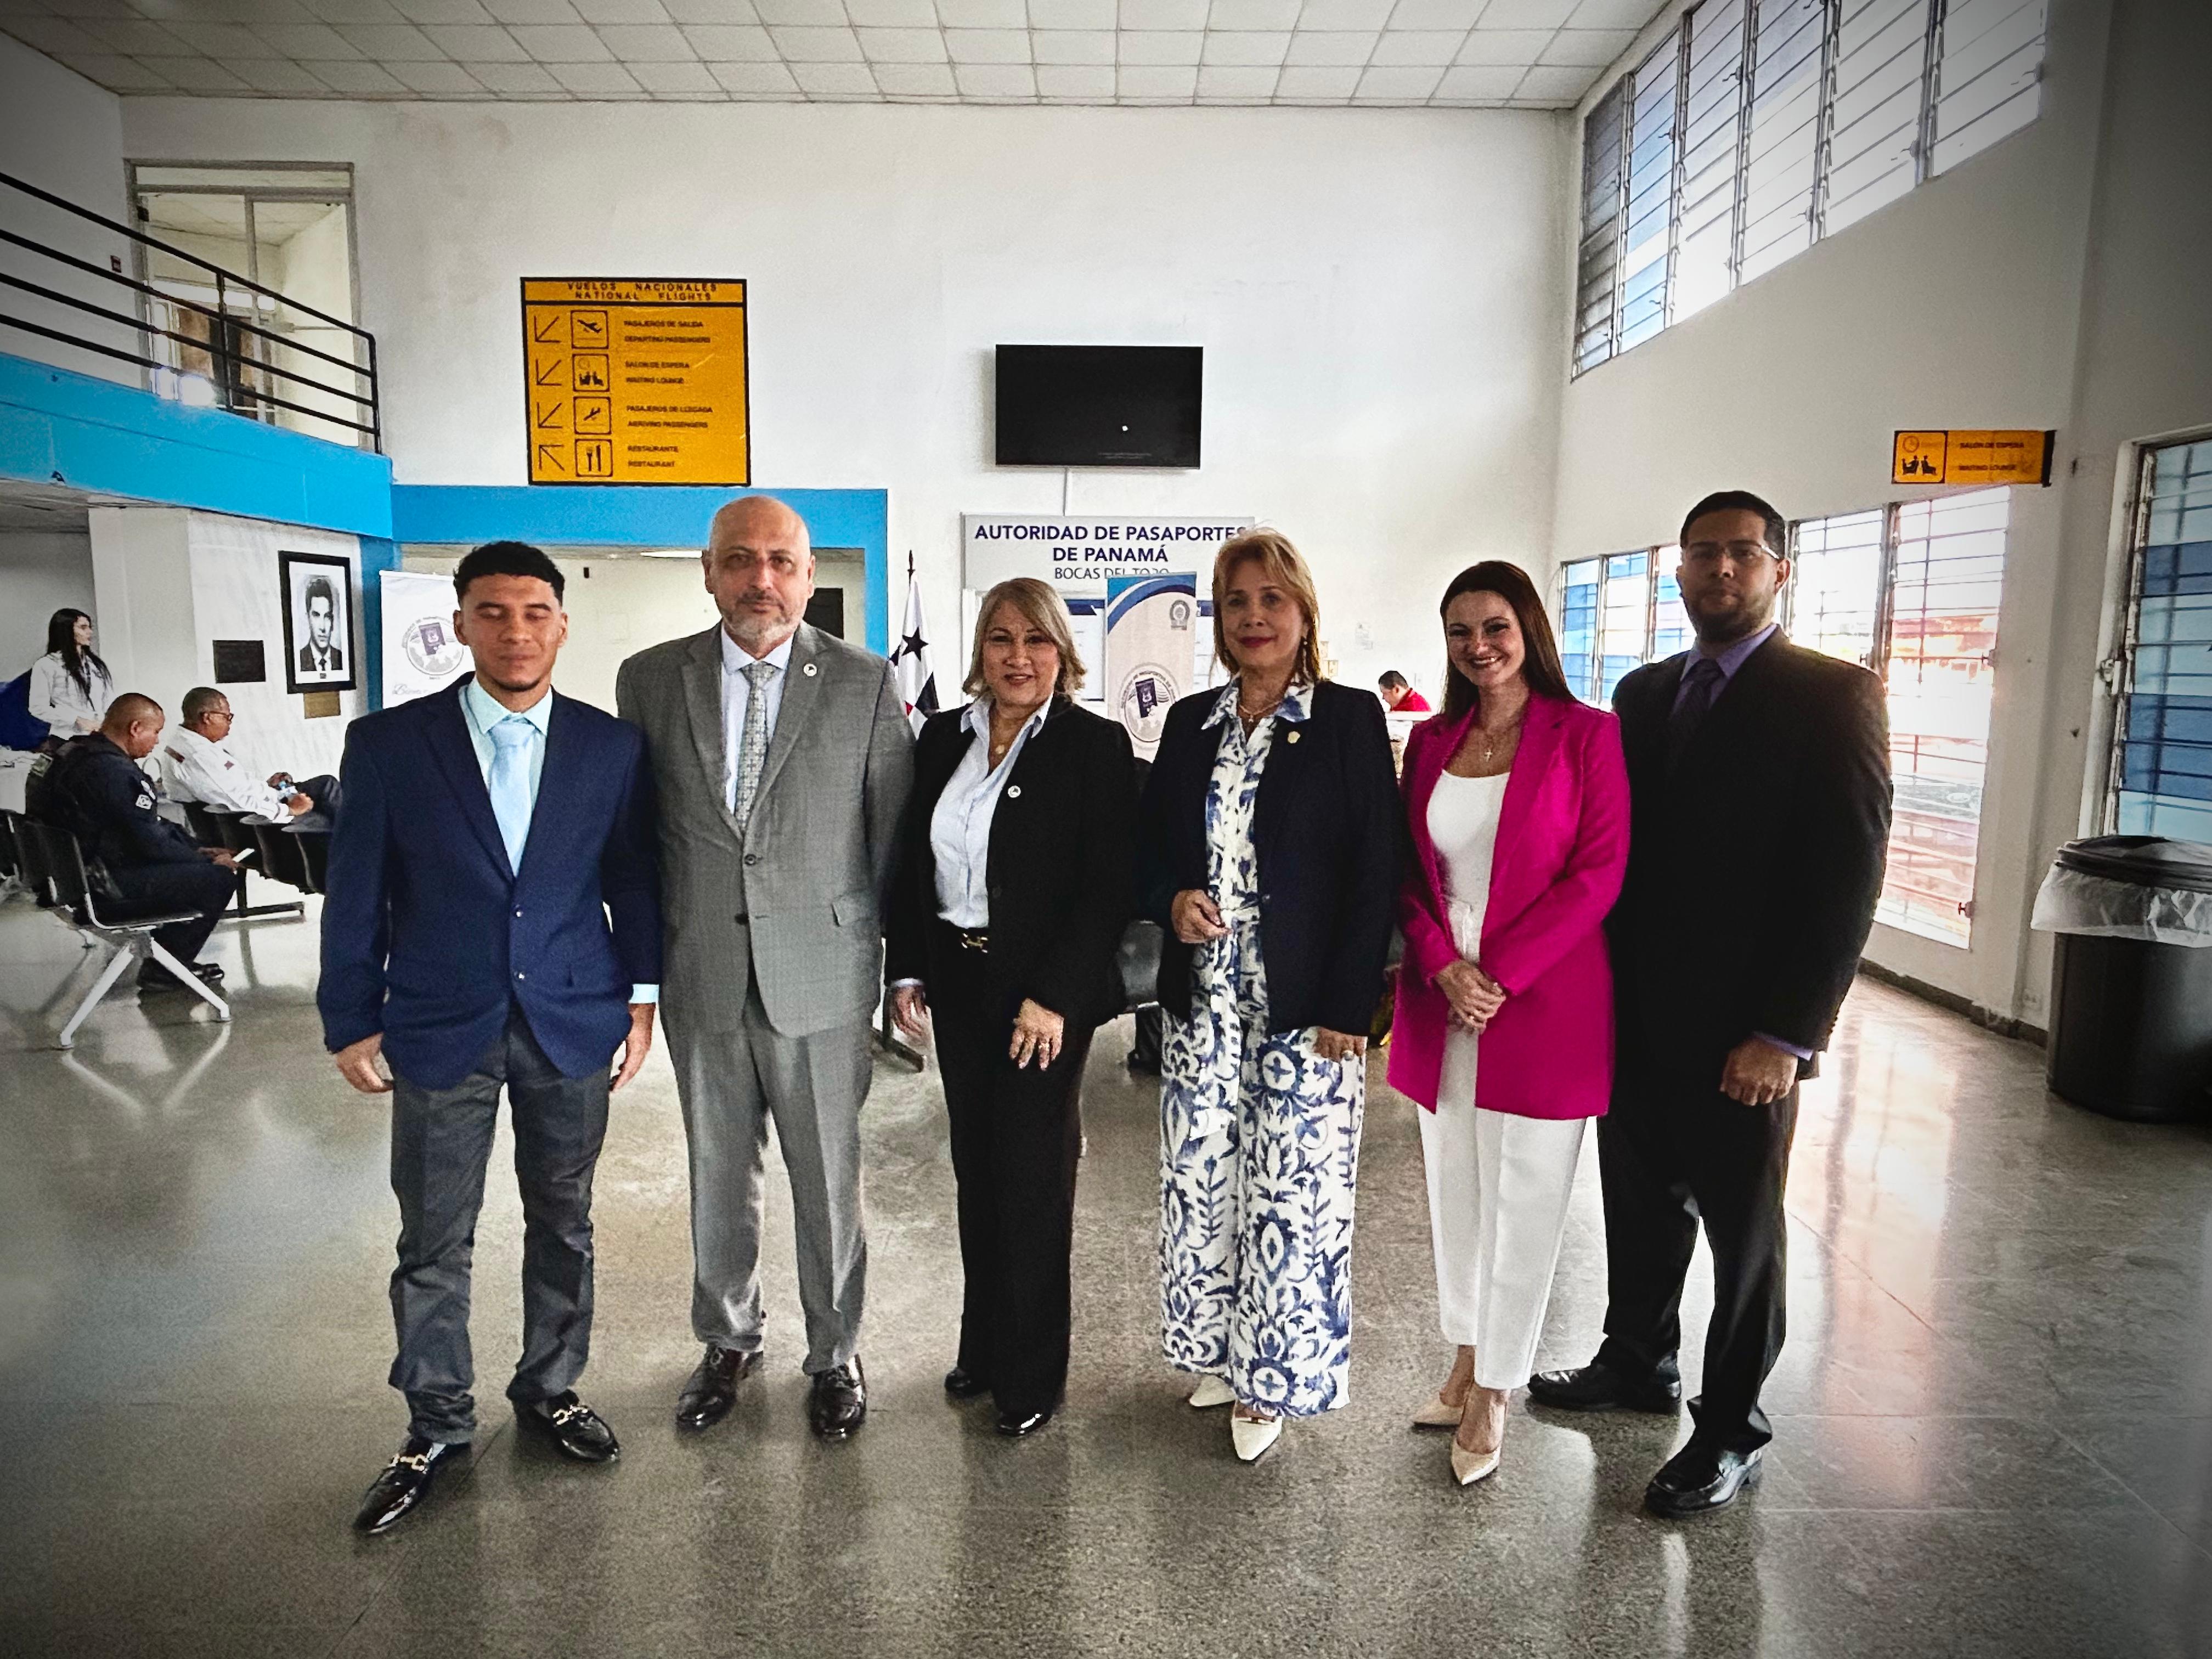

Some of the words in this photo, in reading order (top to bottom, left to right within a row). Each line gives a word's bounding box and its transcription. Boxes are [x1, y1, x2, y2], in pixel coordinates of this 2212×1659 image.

[567, 282, 616, 291] VUELOS
[635, 283, 716, 291] NACIONALES
[575, 291, 639, 300] NATIONAL
[658, 292, 711, 301] FLIGHTS
[974, 525, 1088, 540] AUTORIDAD
[1094, 526, 1120, 540] DE
[1053, 548, 1077, 561] DE
[1085, 545, 1169, 562] PANAMÁ
[1054, 567, 1100, 579] BOCAS
